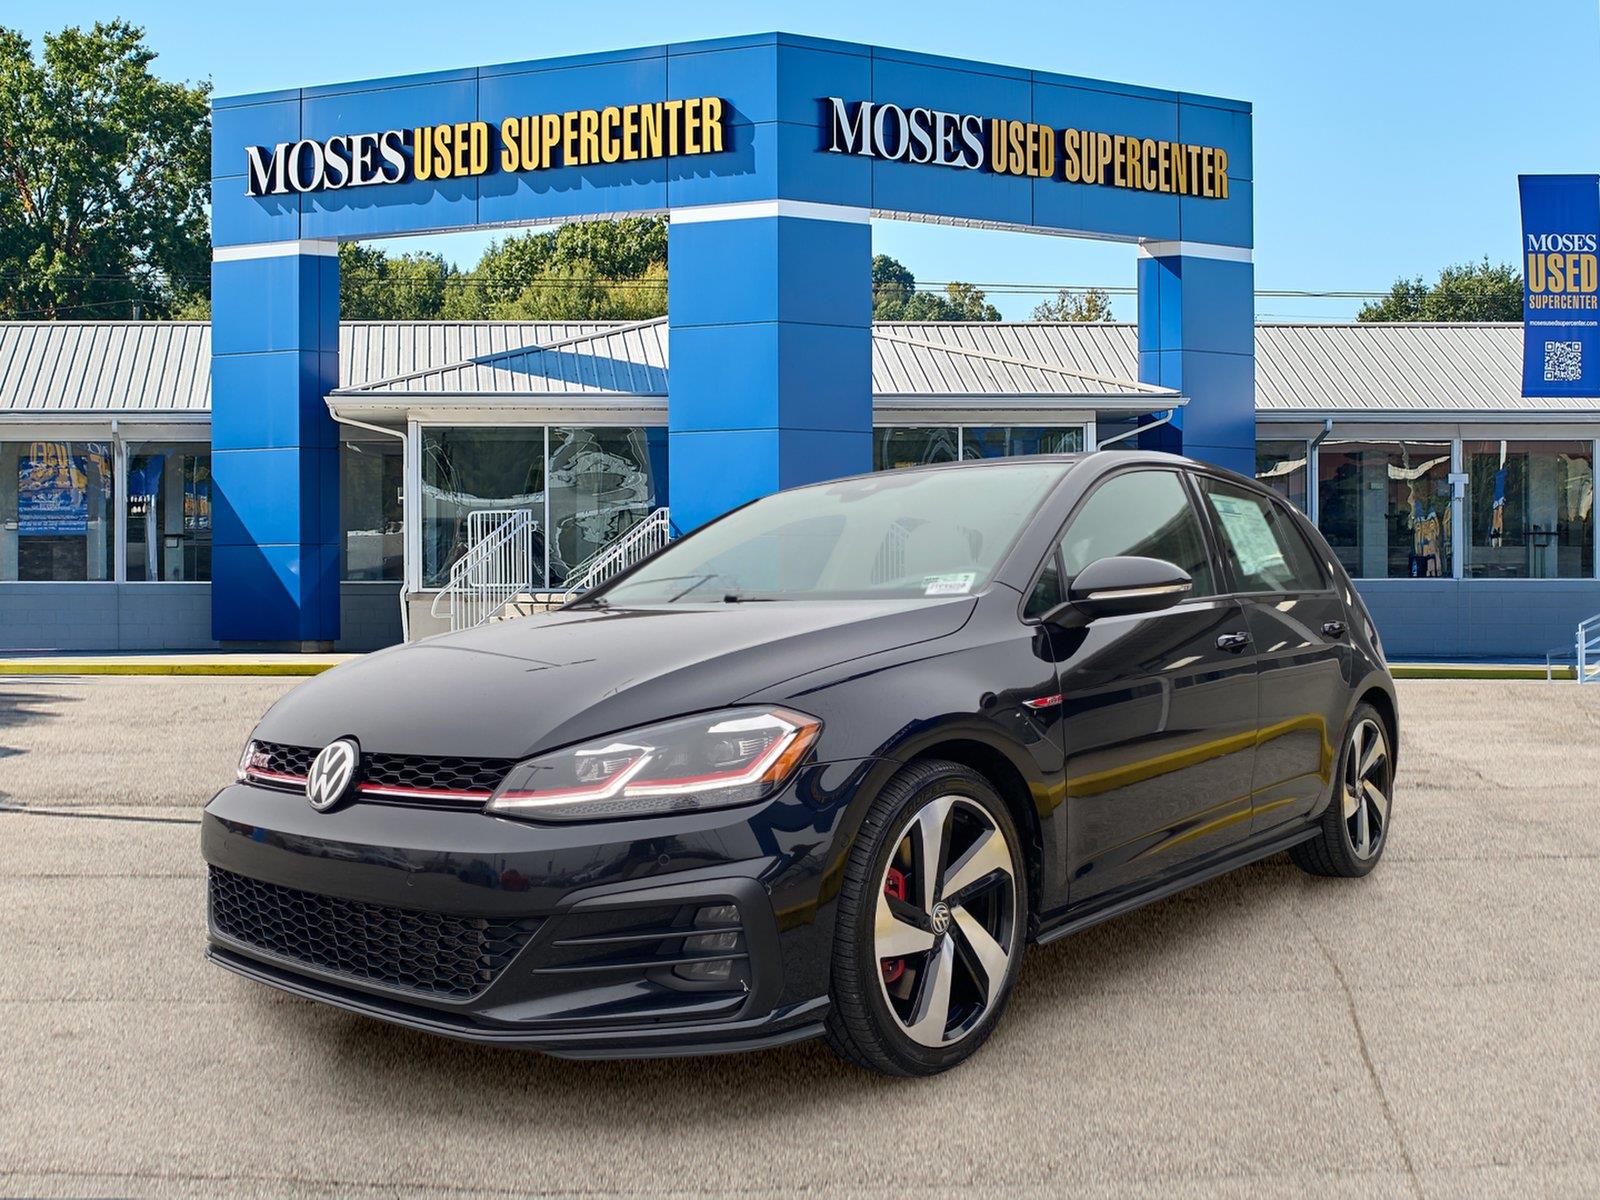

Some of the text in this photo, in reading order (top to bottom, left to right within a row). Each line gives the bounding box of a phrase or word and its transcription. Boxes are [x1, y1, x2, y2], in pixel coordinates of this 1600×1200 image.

[244, 96, 724, 196] MOSES USED SUPERCENTER
[828, 97, 1229, 199] MOSES USED SUPERCENTER
[1527, 234, 1596, 252] MOSES
[1528, 253, 1597, 293] USED
[1529, 295, 1598, 309] SUPERCENTER
